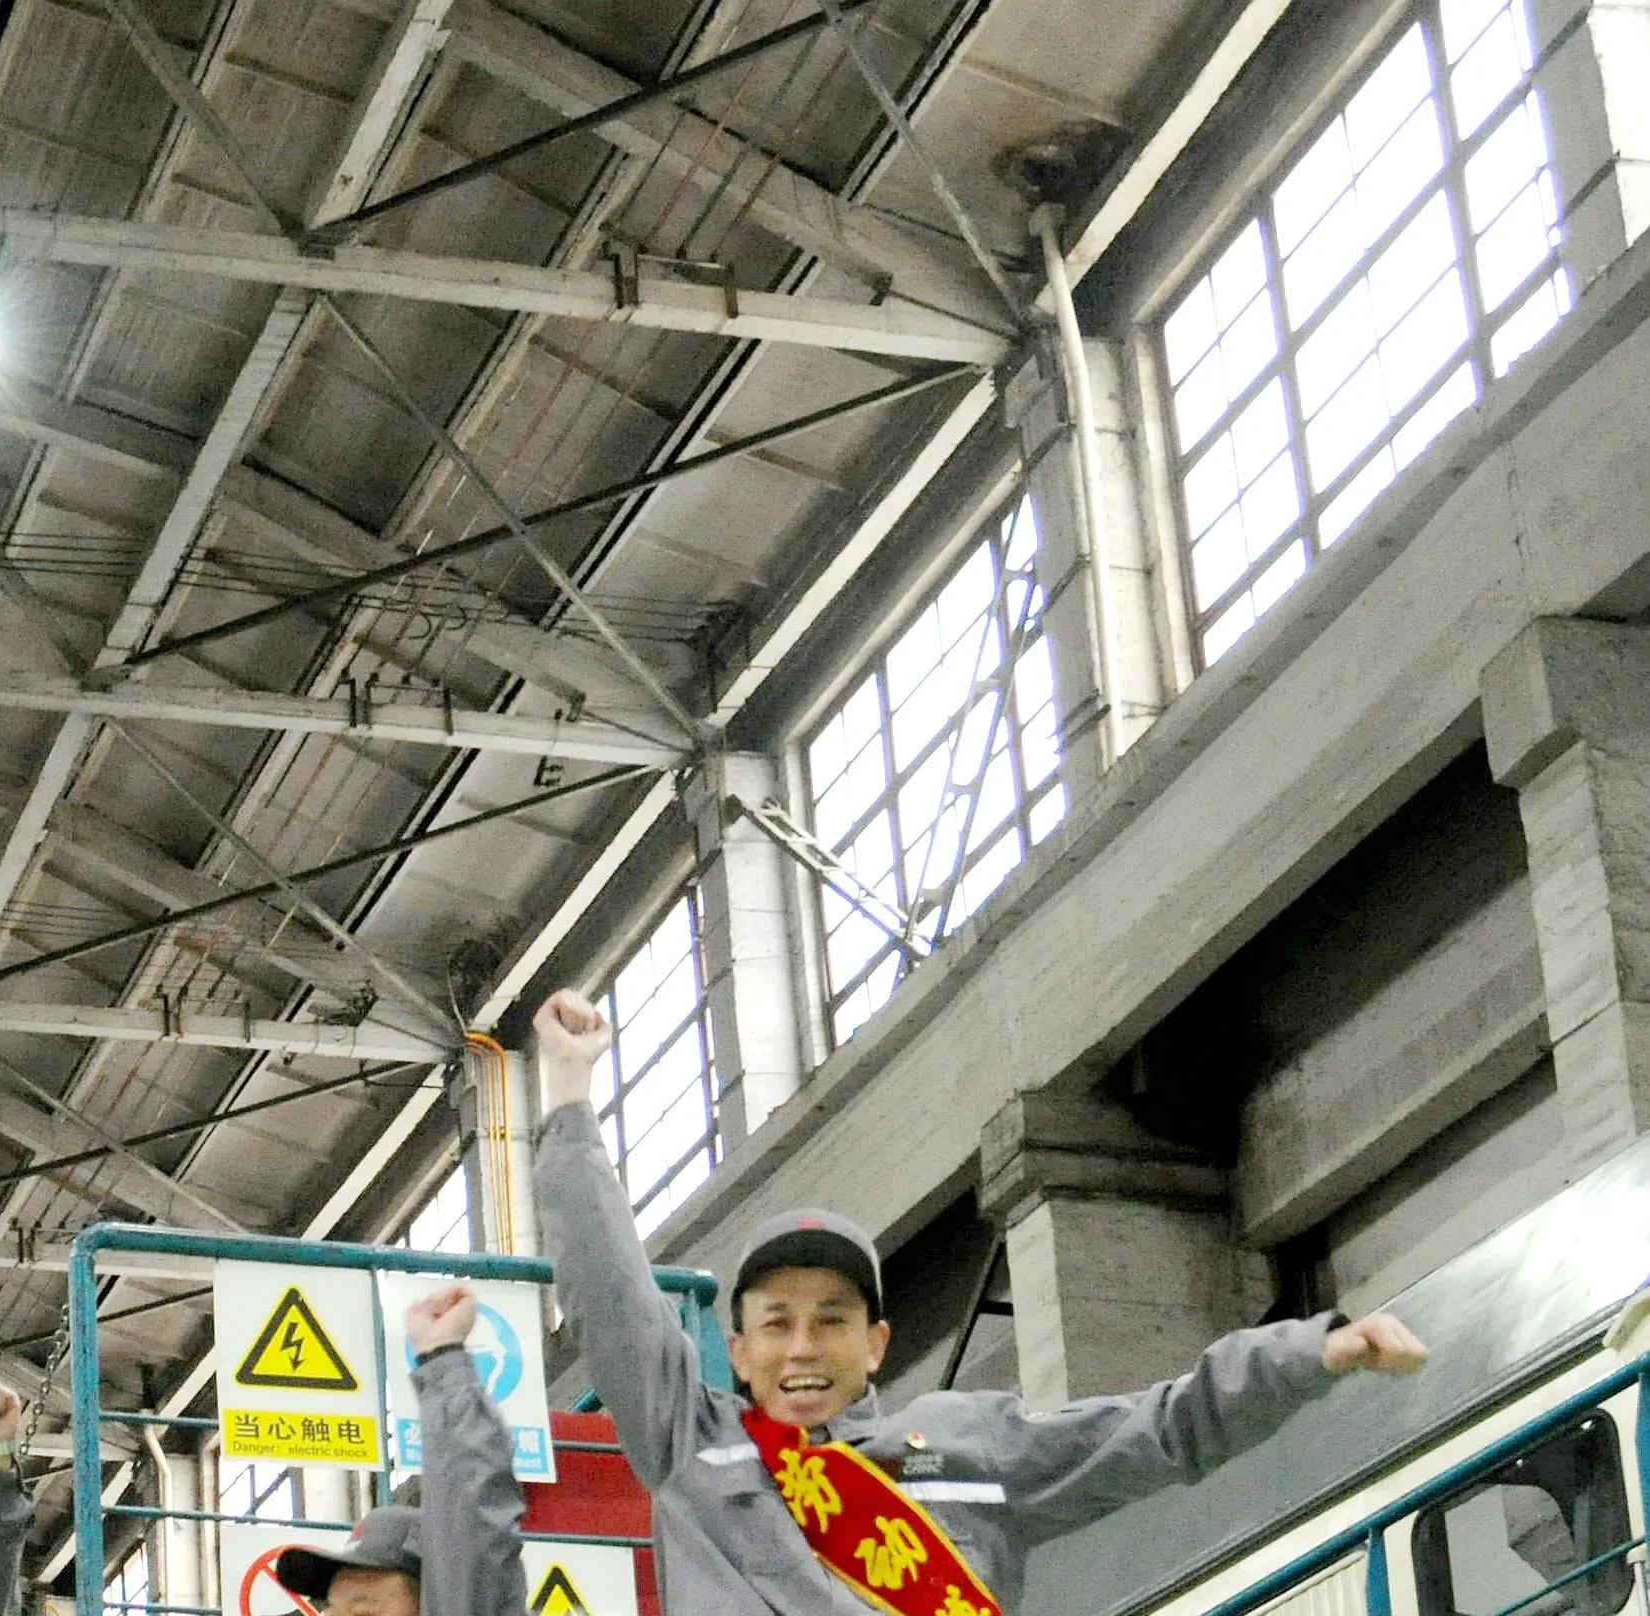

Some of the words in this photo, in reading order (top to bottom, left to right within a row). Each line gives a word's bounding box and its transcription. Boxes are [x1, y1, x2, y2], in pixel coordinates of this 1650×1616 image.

[235, 1414, 365, 1444] 当心触电
[288, 1445, 331, 1456] electric
[333, 1447, 369, 1459] shock
